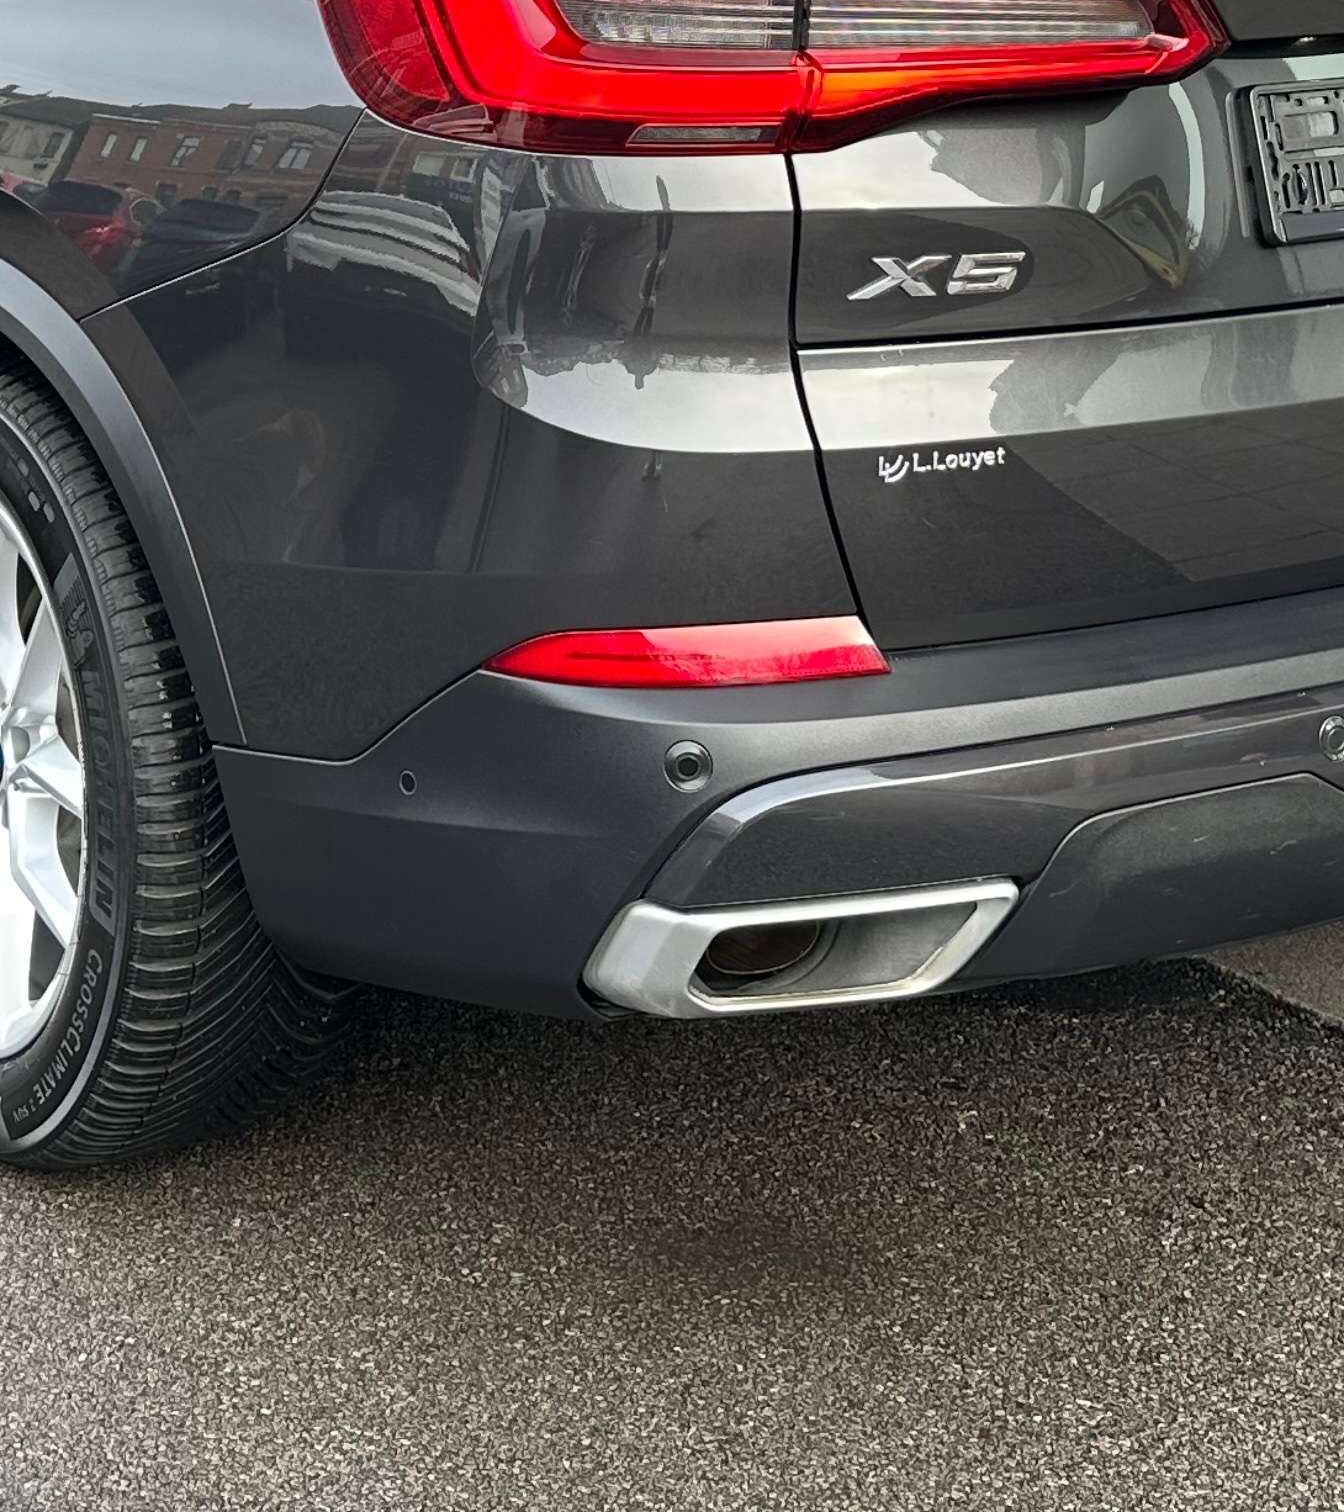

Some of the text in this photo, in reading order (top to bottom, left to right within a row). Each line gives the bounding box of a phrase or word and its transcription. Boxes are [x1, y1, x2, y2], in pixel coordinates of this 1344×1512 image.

[846, 250, 1027, 301] X5
[912, 446, 1006, 472] L.Louyet
[80, 670, 114, 918] MICHELIN
[32, 948, 103, 1106] CROSSCLIMATE
